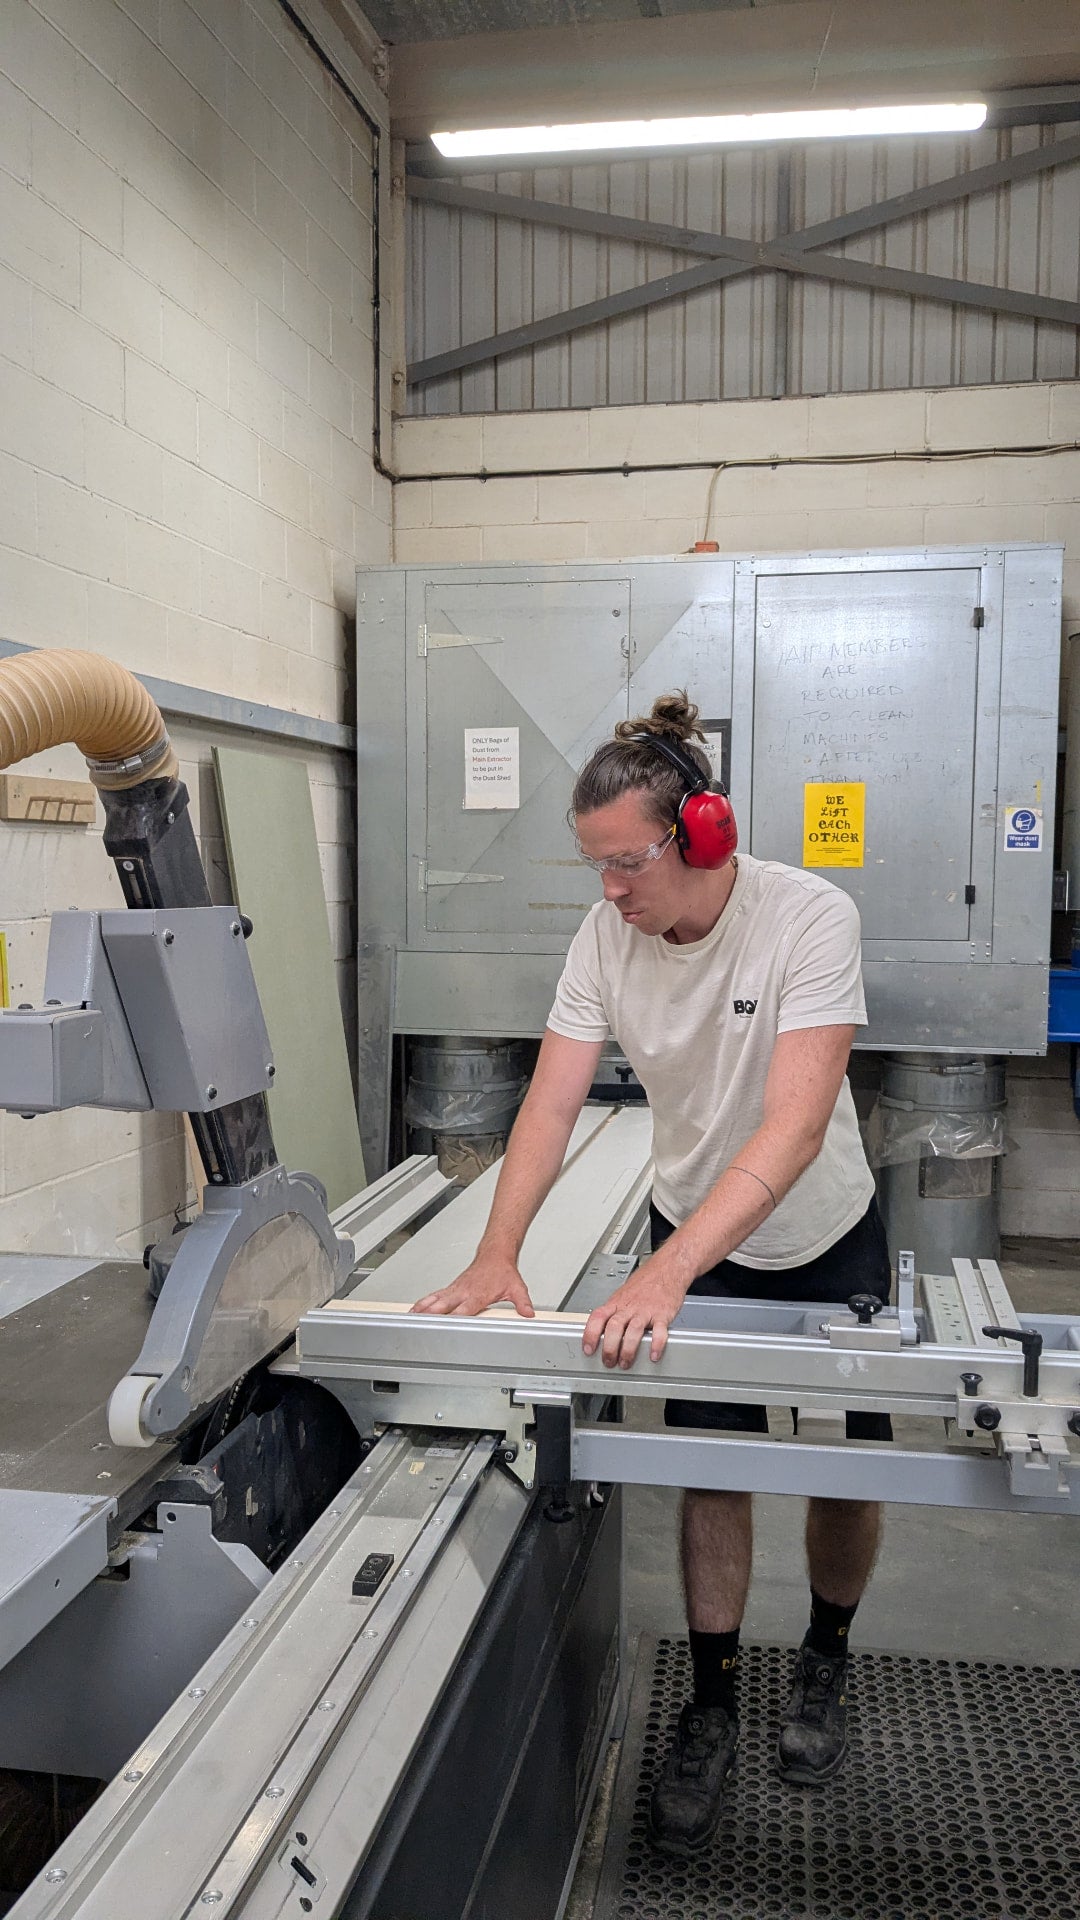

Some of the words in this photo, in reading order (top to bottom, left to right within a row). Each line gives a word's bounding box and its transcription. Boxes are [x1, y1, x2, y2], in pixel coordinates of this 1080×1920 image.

[822, 664, 857, 678] ARE
[801, 686, 904, 703] REQUIRED
[803, 709, 832, 722] TO
[849, 709, 914, 721] CLEAN
[803, 732, 889, 746] MACHINES
[825, 795, 844, 805] WE
